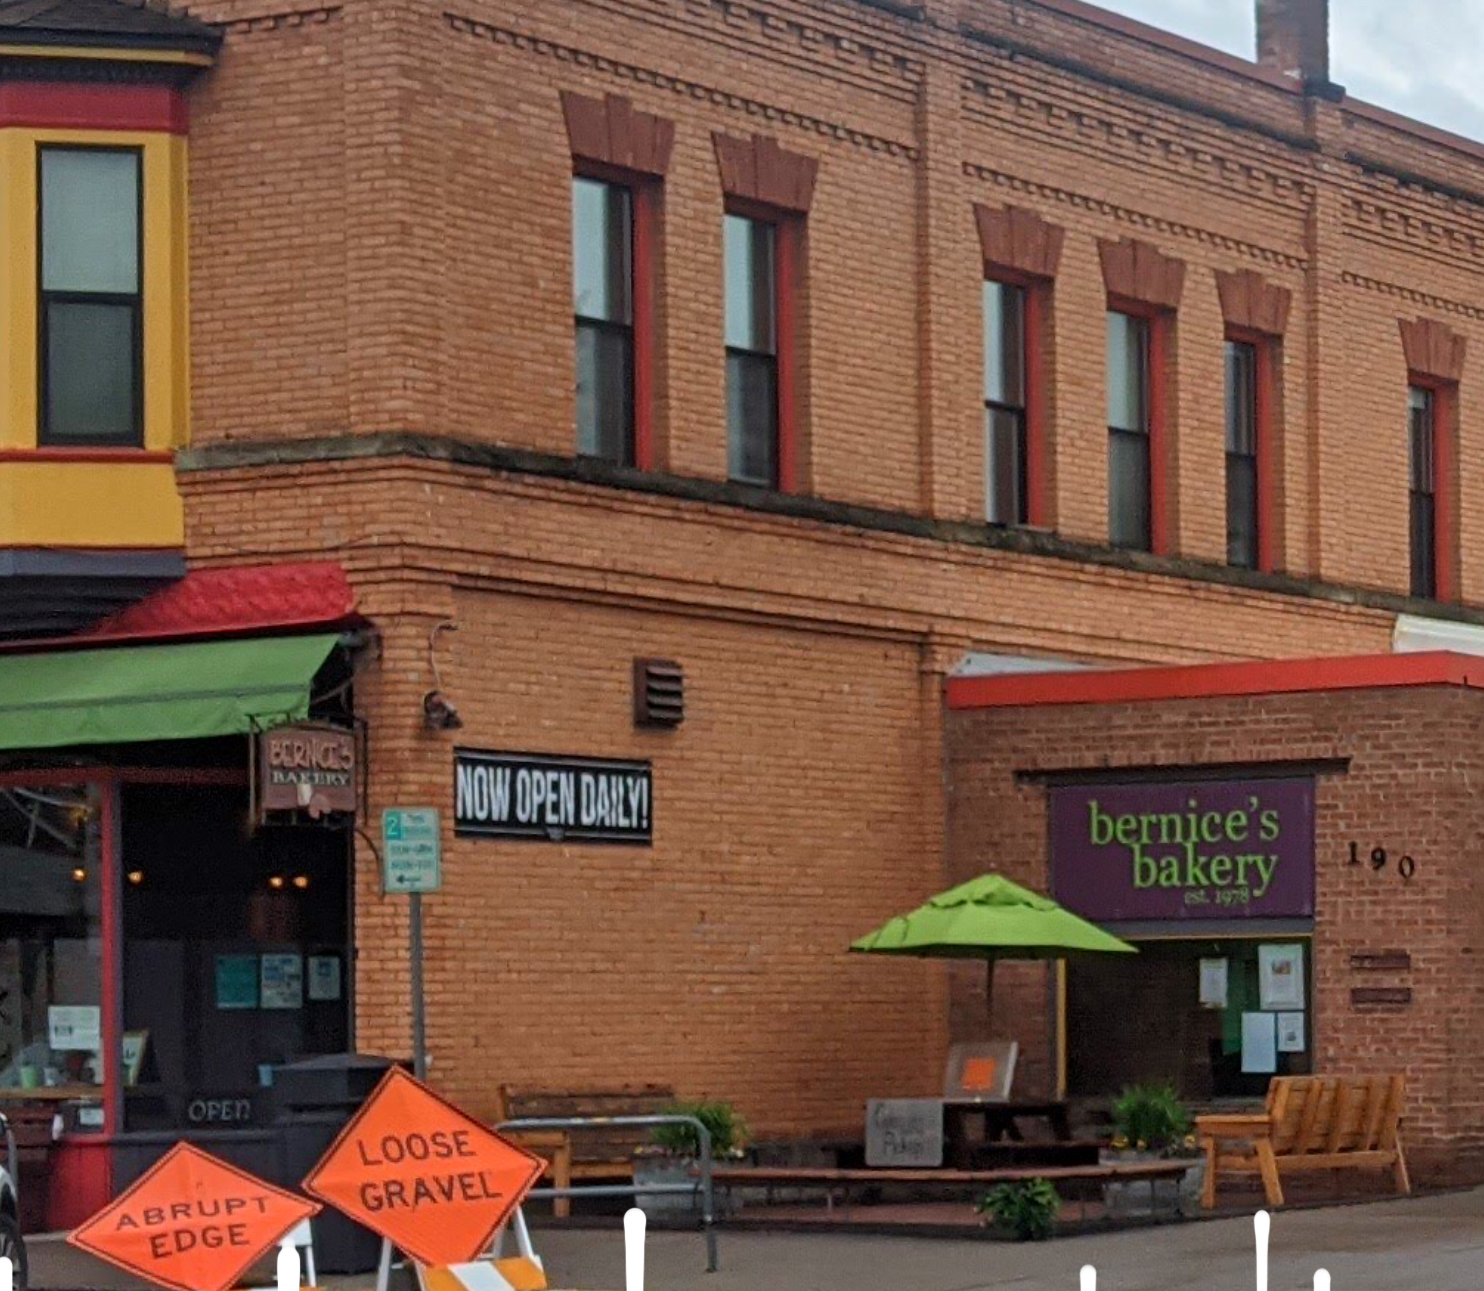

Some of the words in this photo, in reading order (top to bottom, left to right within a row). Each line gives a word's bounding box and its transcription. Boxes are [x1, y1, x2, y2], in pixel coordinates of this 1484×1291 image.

[272, 770, 350, 787] BAKERY
[456, 764, 510, 822] NOW
[516, 768, 575, 826] OPEN
[580, 773, 649, 829] DAILY!
[1088, 795, 1282, 846] bernice's
[1132, 842, 1280, 897] bakery
[1347, 841, 1417, 881] 190
[1184, 889, 1211, 905] est.
[1215, 888, 1252, 907] 1978
[357, 1130, 476, 1167] LOOSE
[359, 1171, 504, 1213] GRAVEL
[115, 1195, 271, 1232] ABRUPT
[149, 1223, 250, 1260] EDGE
